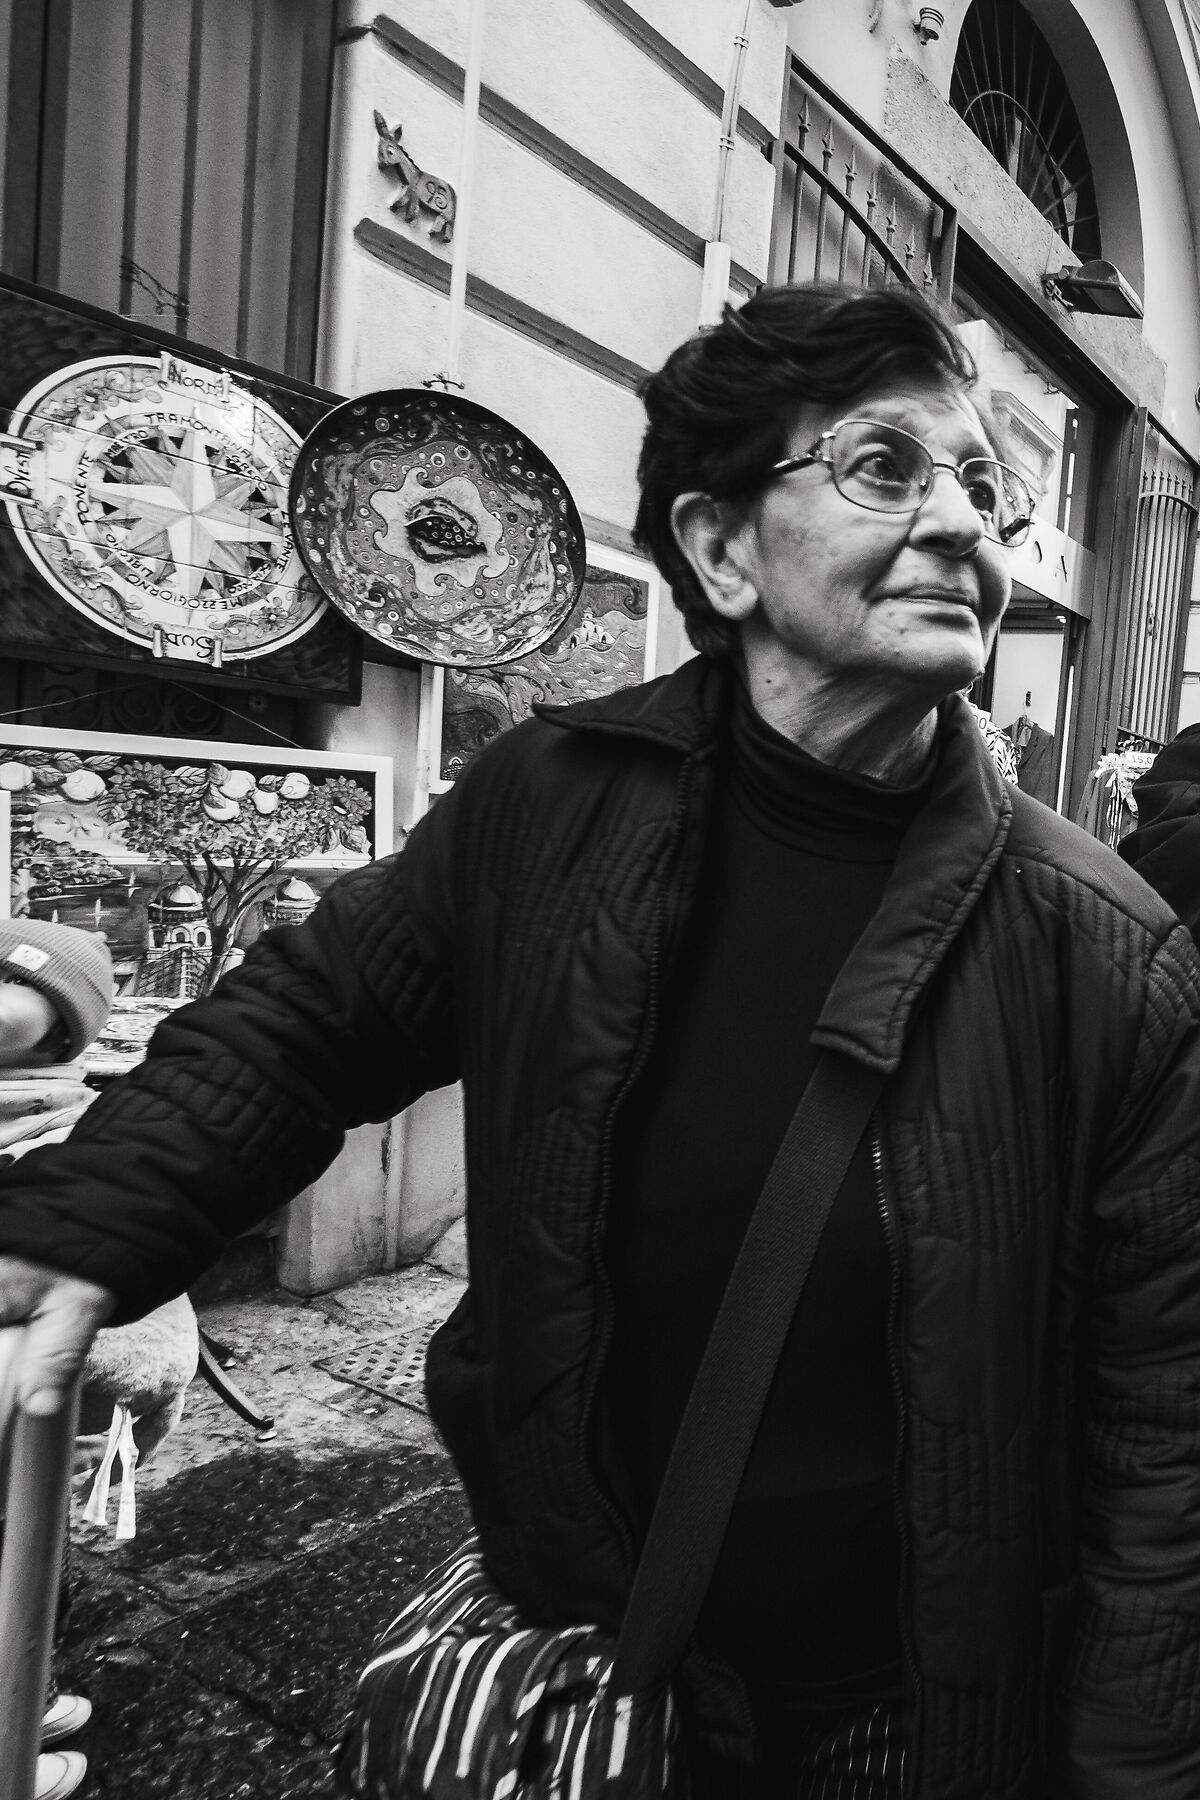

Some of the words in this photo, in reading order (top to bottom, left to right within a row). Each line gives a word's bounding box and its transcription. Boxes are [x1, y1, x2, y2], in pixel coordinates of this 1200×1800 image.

[104, 430, 148, 459] MAETRO
[144, 412, 251, 458] TRAMONTANA
[74, 450, 95, 525] PONENTE
[275, 511, 294, 573] LEVANTE
[166, 632, 214, 658] SUD
[1132, 755, 1153, 765] 15,0
